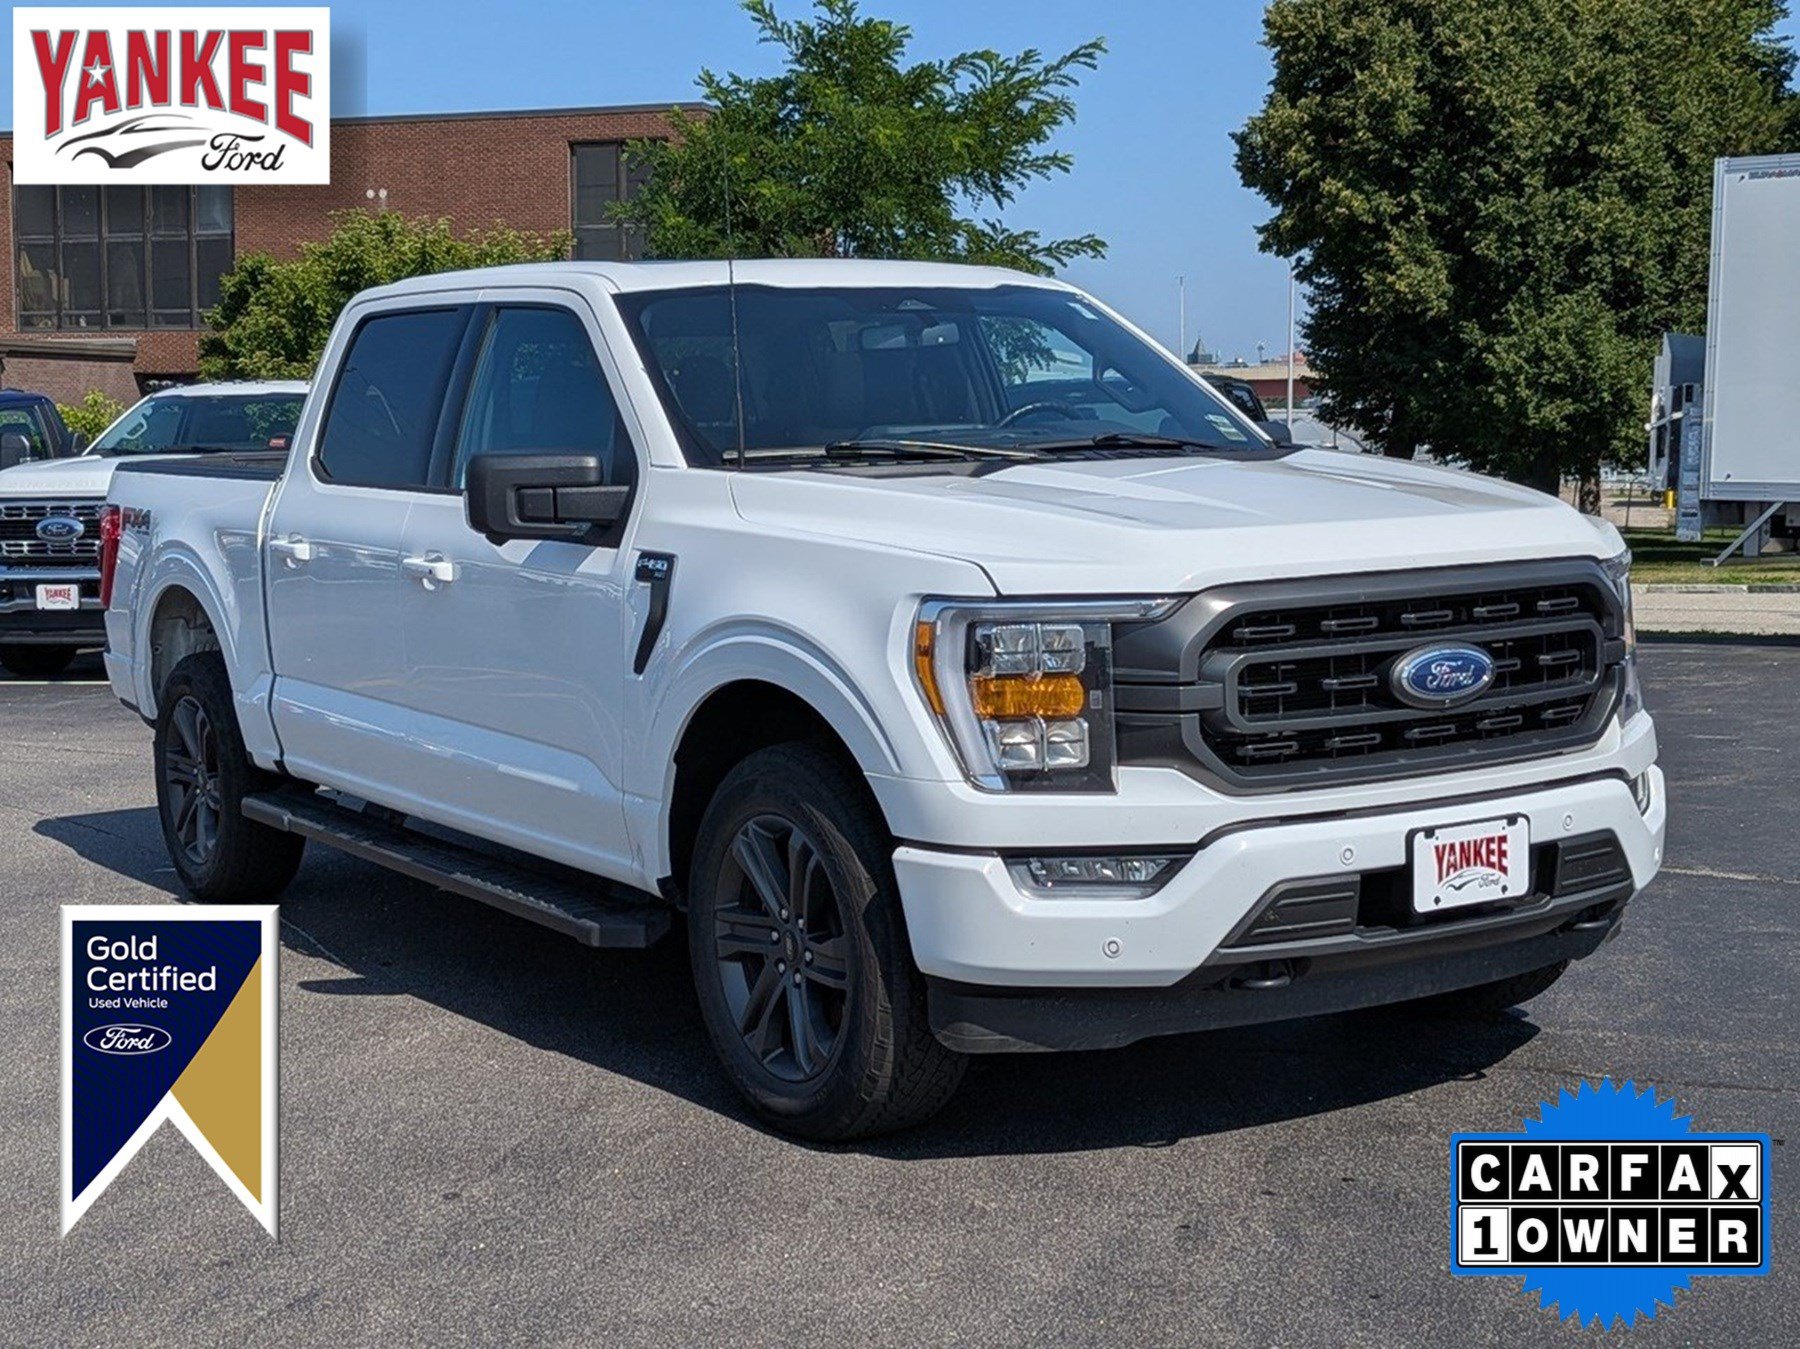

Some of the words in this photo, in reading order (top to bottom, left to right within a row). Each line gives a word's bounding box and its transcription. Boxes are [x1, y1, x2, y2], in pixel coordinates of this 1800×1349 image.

[44, 586, 72, 601] YANKEE
[1426, 661, 1474, 688] Ford
[1434, 834, 1508, 885] YANKEE
[1478, 873, 1501, 888] Ford
